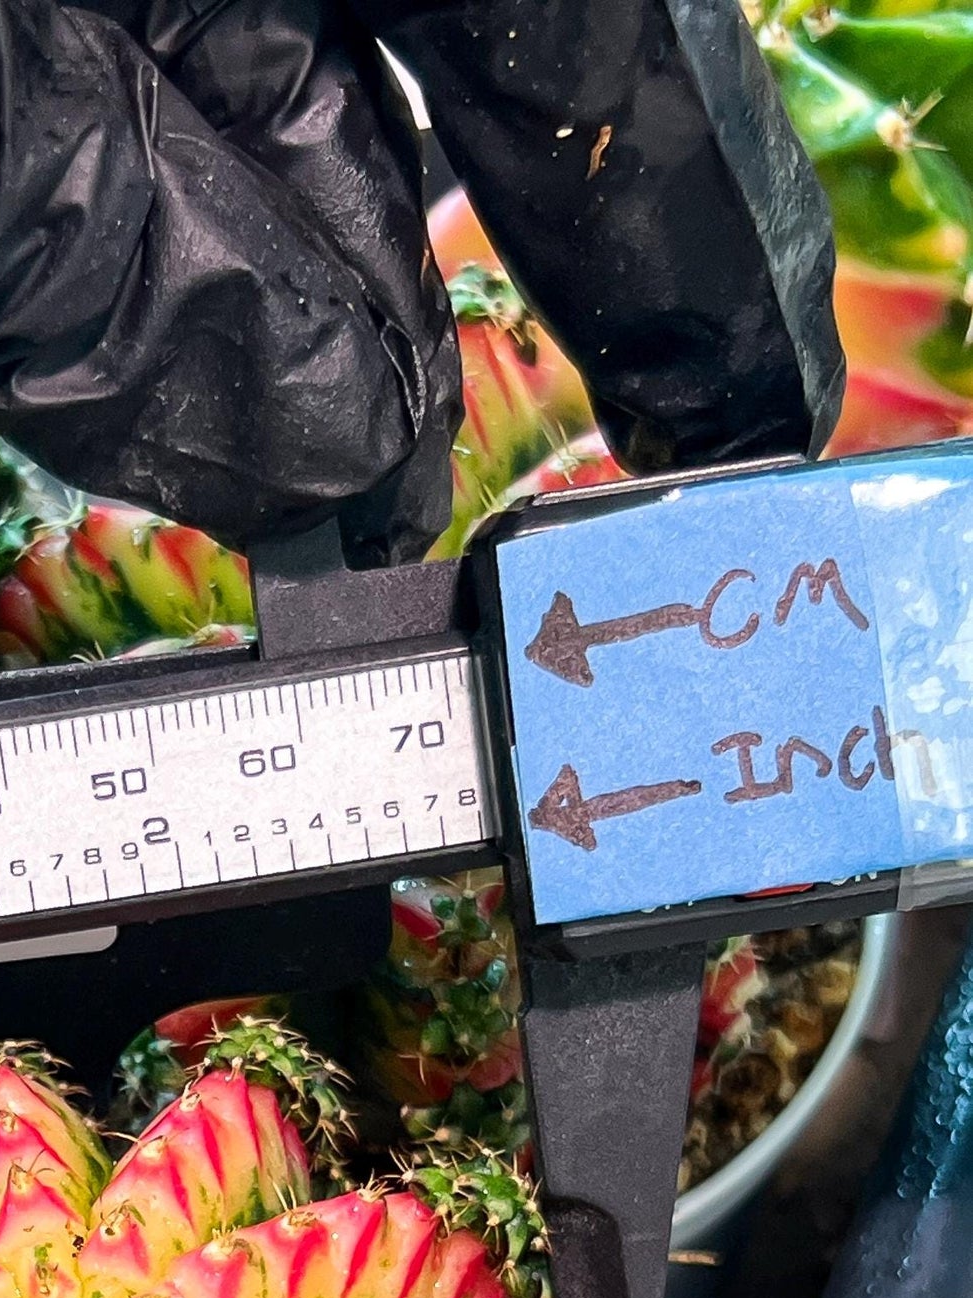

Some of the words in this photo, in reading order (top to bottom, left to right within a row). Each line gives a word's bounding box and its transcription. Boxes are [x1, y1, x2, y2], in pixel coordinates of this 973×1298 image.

[699, 558, 869, 649] CM
[90, 768, 148, 800] 50
[239, 745, 296, 777] 60
[389, 721, 445, 753] 70
[10, 860, 26, 877] 6
[49, 854, 64, 870] 7
[83, 848, 102, 865] 8
[121, 842, 139, 860] 9
[143, 817, 172, 845] 2
[233, 825, 251, 842] 2
[271, 818, 288, 835] 3
[309, 813, 324, 830] 4
[345, 807, 362, 825] 5
[383, 801, 400, 818] 6
[423, 794, 439, 812] 7
[458, 788, 477, 806] 8
